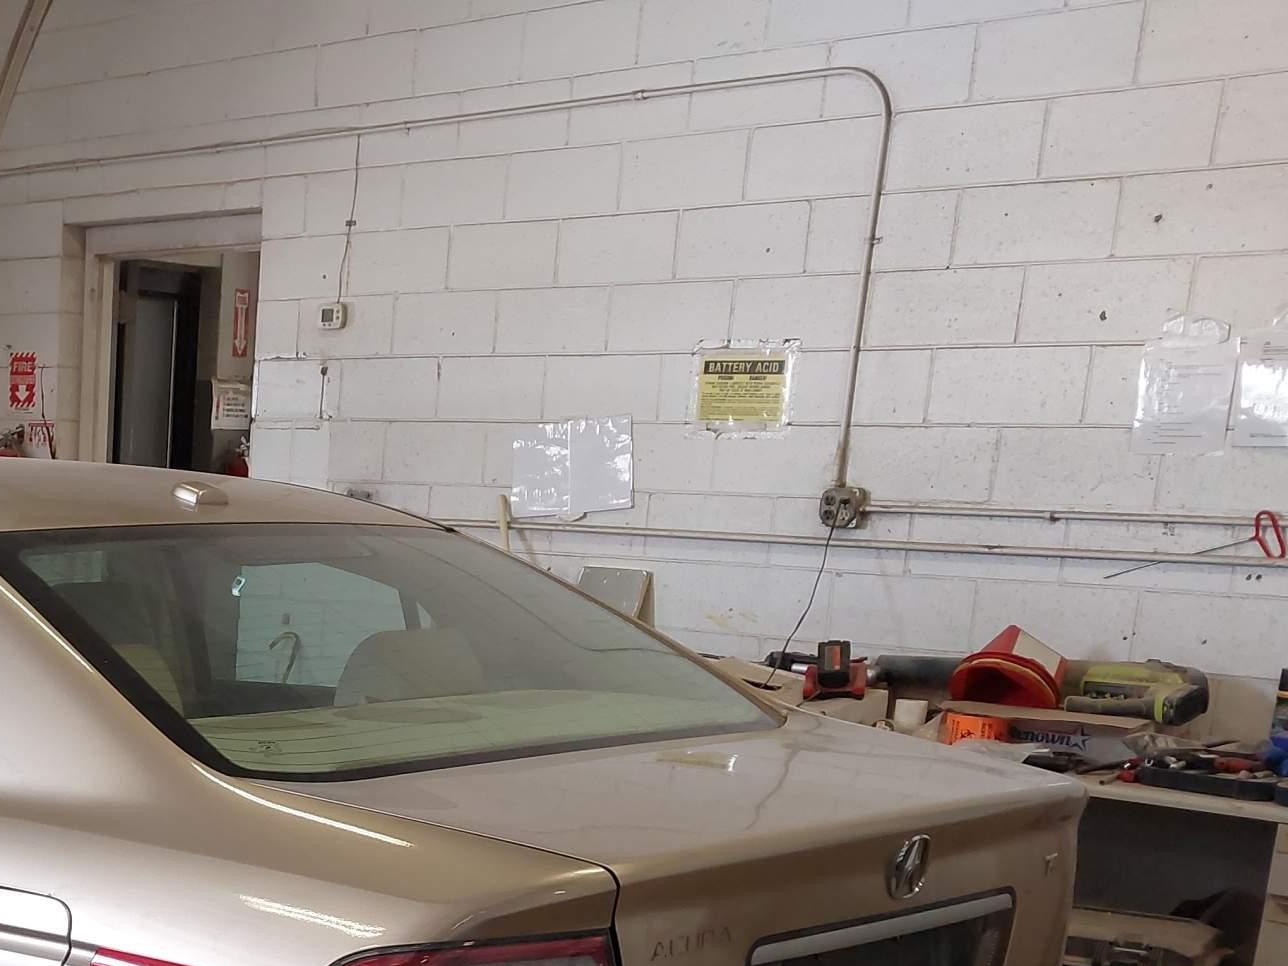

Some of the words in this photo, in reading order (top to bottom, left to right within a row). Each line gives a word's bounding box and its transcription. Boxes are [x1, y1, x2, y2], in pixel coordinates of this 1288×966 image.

[13, 362, 33, 373] FIRE
[708, 362, 753, 373] BATTERY
[755, 362, 779, 373] ACID
